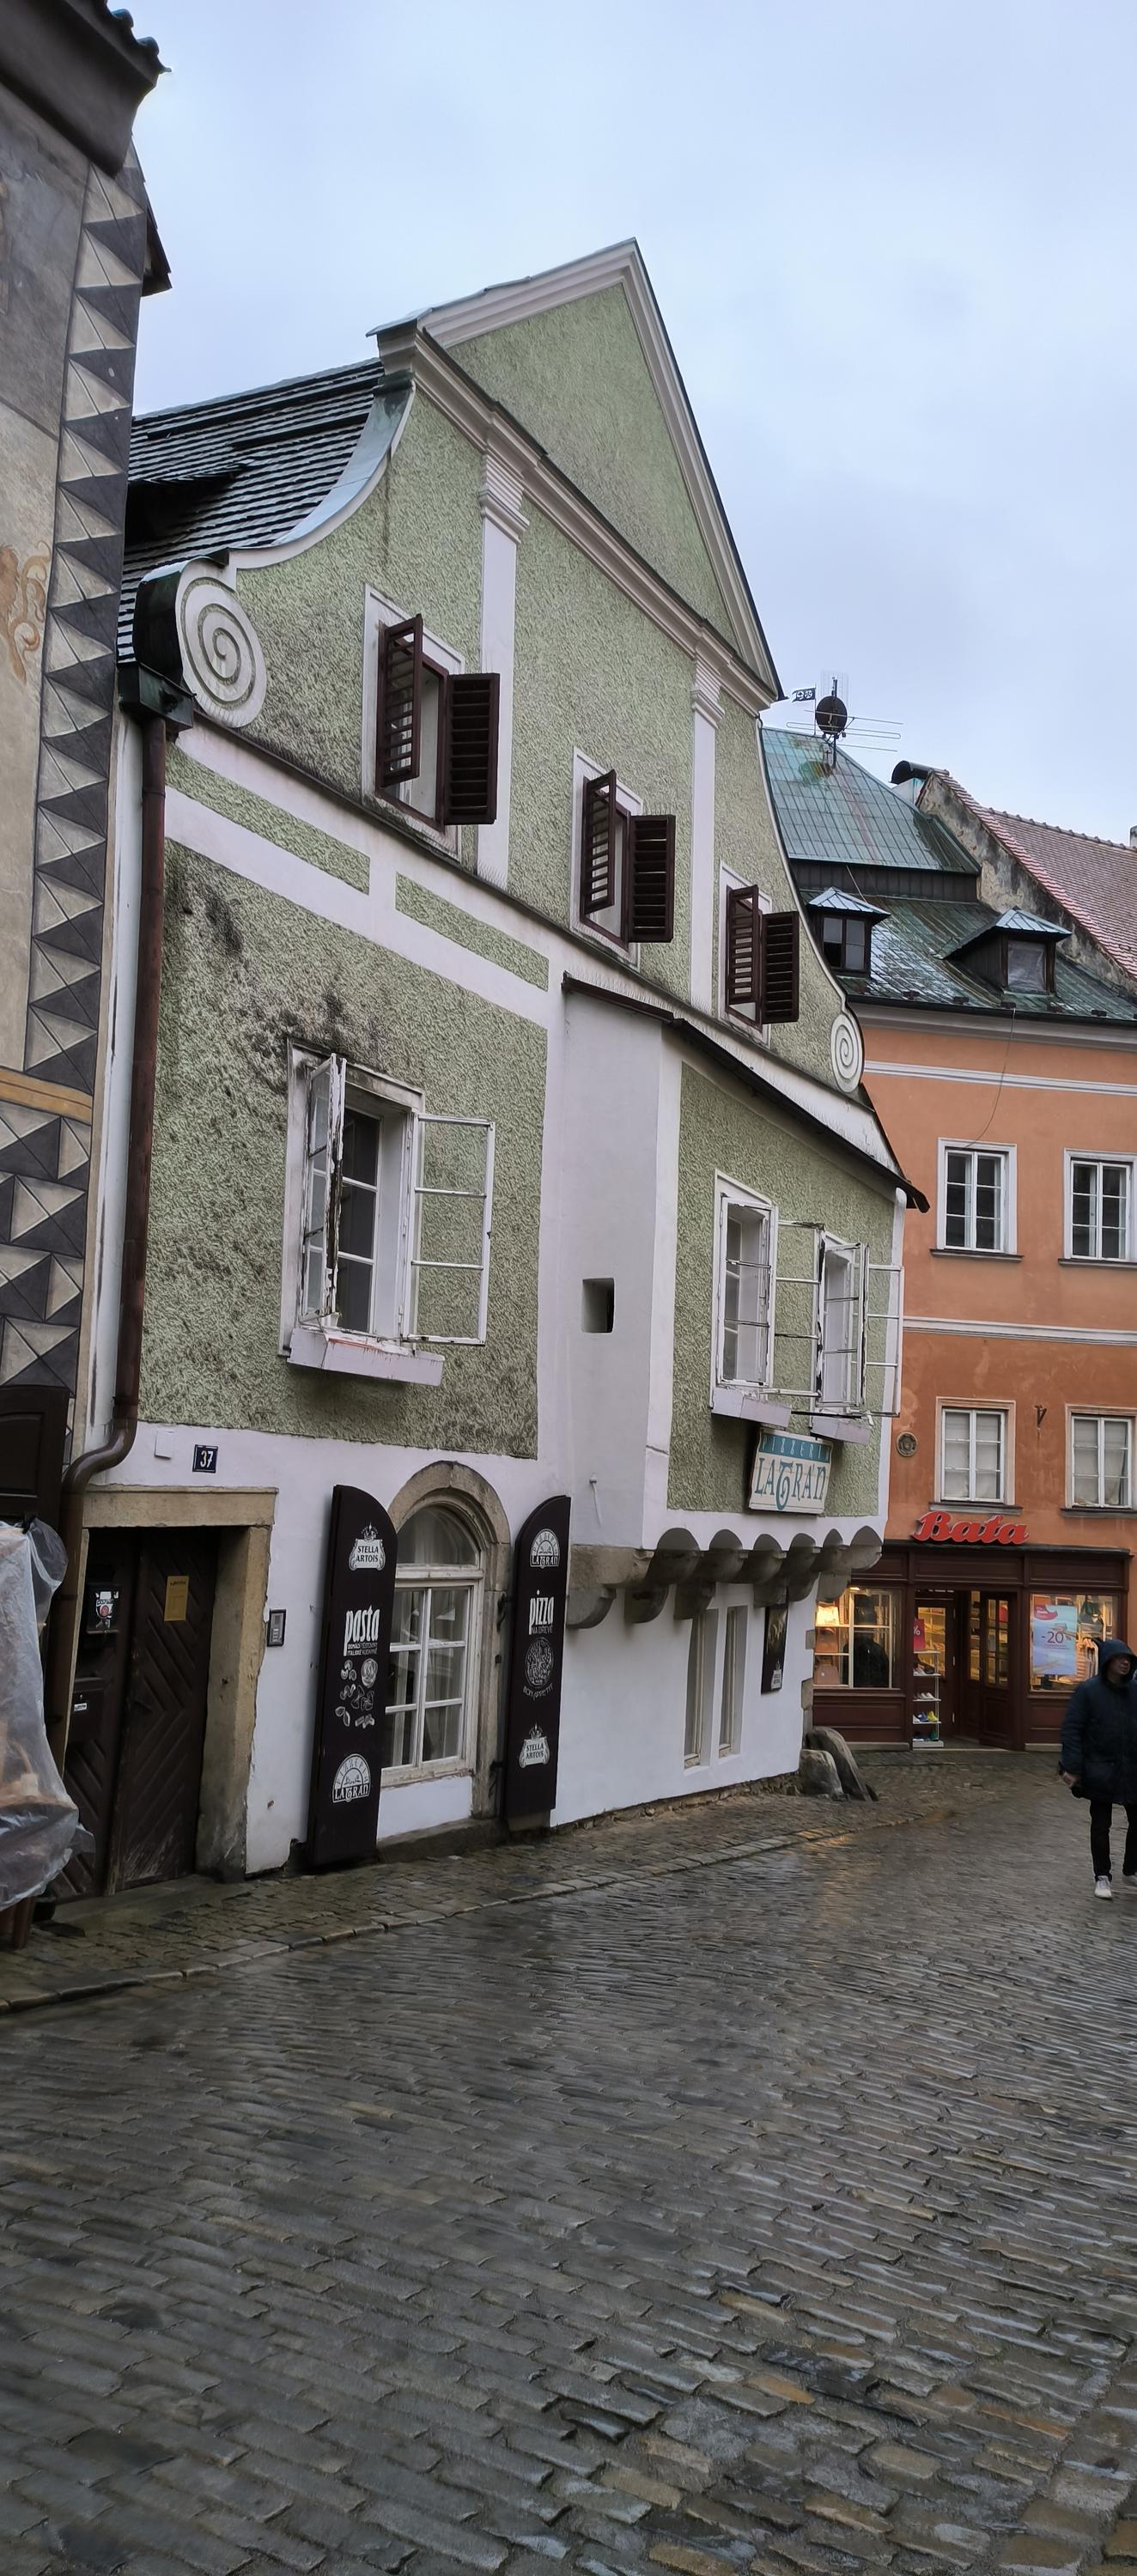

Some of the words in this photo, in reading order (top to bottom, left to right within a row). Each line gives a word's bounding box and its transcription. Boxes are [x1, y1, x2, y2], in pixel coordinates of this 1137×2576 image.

[200, 1449, 214, 1468] 37
[357, 1545, 379, 1553] STELLA
[356, 1554, 379, 1563] ARTOIS
[529, 1589, 555, 1635] pizza
[344, 1604, 380, 1656] pasta
[526, 1743, 544, 1752] STELLA
[526, 1751, 544, 1759] ARTOIS
